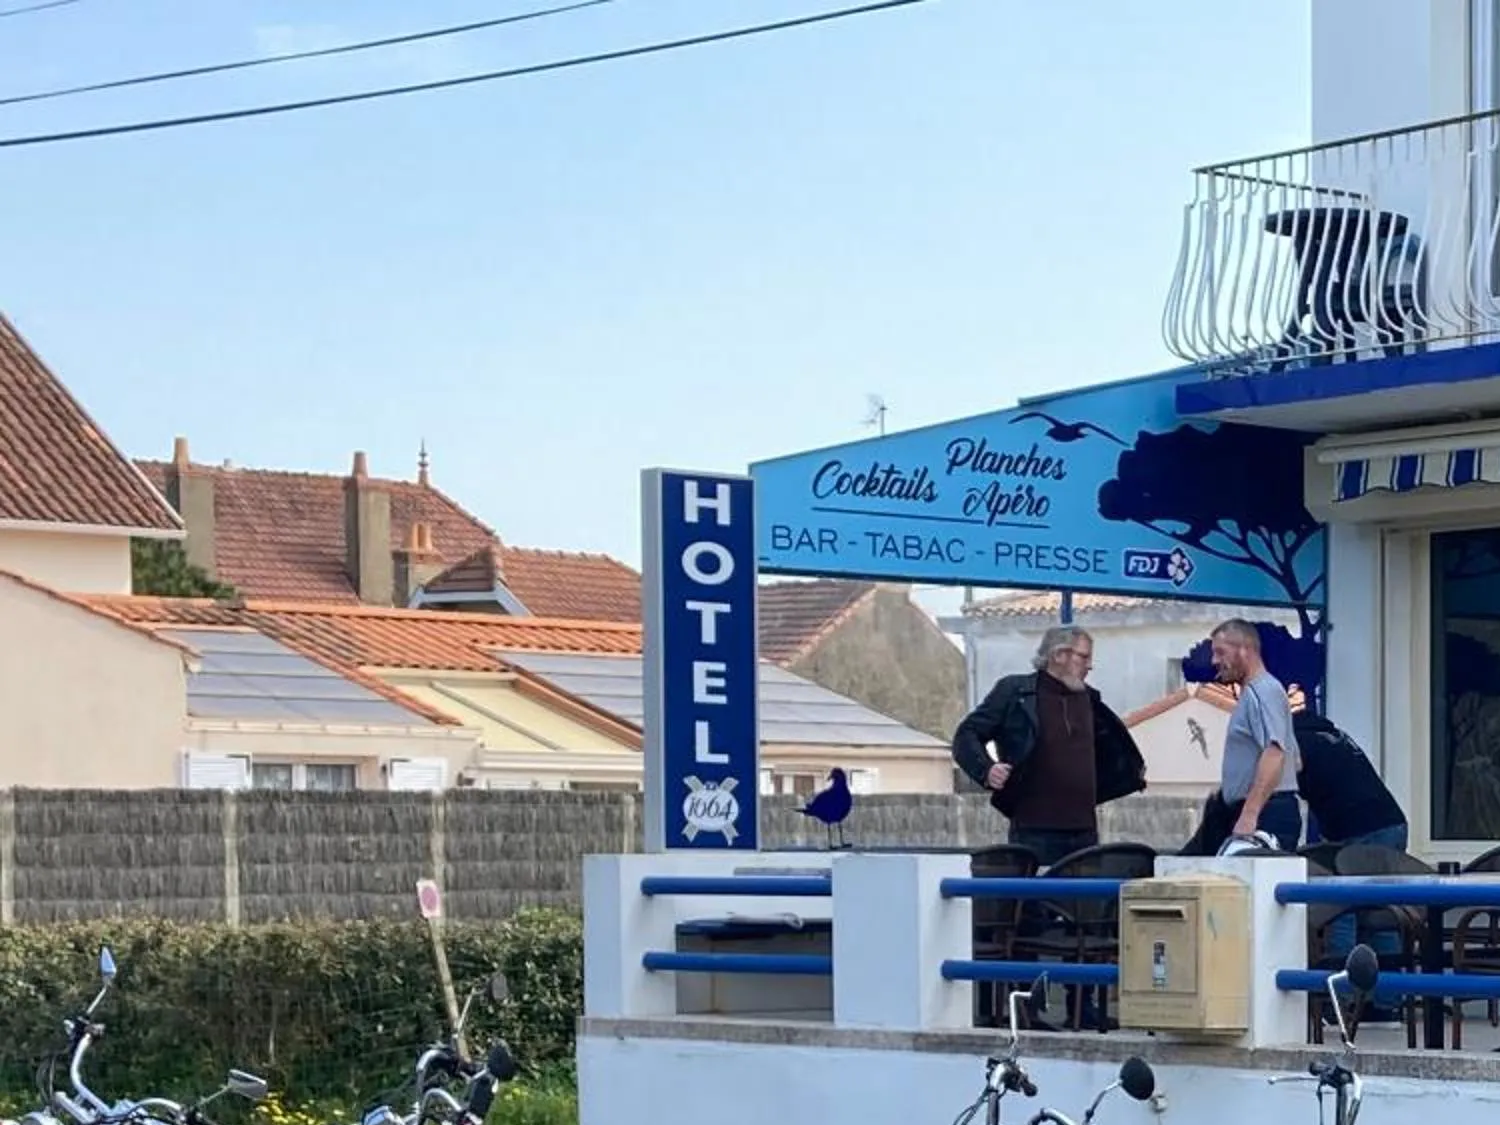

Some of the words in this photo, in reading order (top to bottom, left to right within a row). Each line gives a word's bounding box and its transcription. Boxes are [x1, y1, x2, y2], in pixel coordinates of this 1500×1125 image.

[811, 459, 939, 503] Cocktails
[945, 437, 1067, 481] Planches
[962, 480, 1051, 527] Apéro
[771, 525, 839, 554] BAR
[864, 531, 966, 563] TABAC
[994, 541, 1110, 574] PRESSE
[1127, 556, 1161, 574] FDJ
[681, 479, 735, 765] HOTEL
